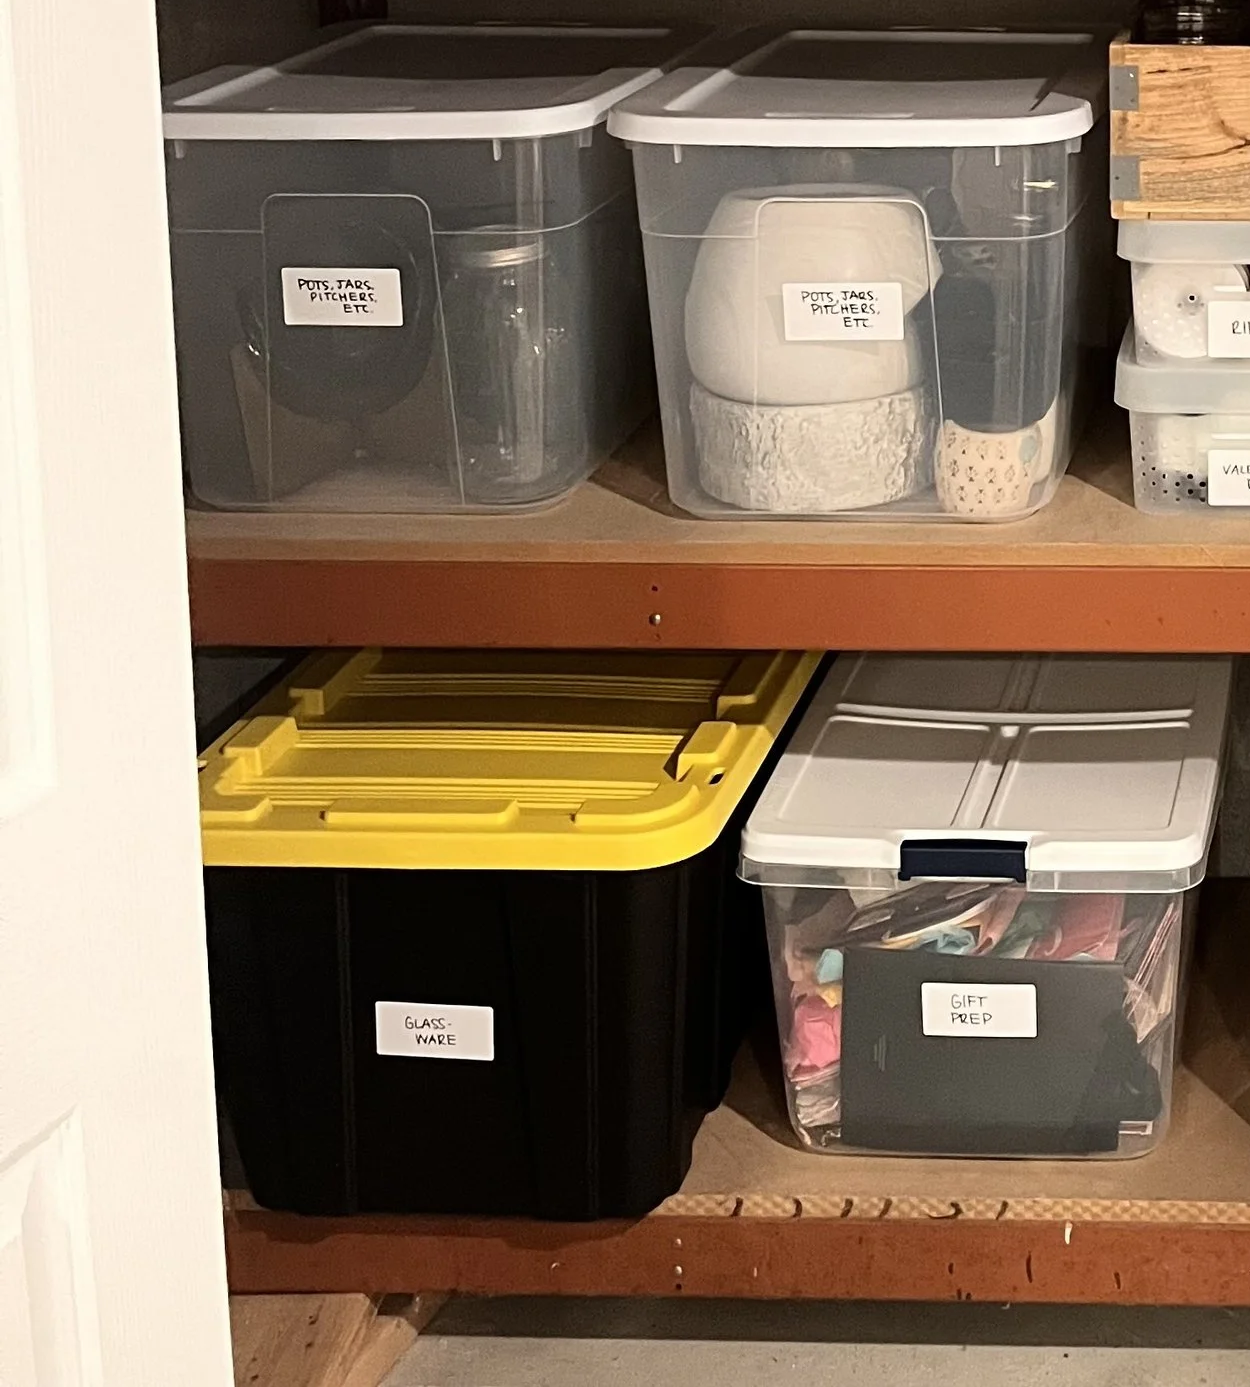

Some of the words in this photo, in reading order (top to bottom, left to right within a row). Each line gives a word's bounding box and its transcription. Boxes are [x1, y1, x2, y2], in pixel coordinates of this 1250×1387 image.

[951, 995, 988, 1009] GIFT
[951, 1012, 992, 1025] PREP
[415, 1034, 456, 1045] WARE
